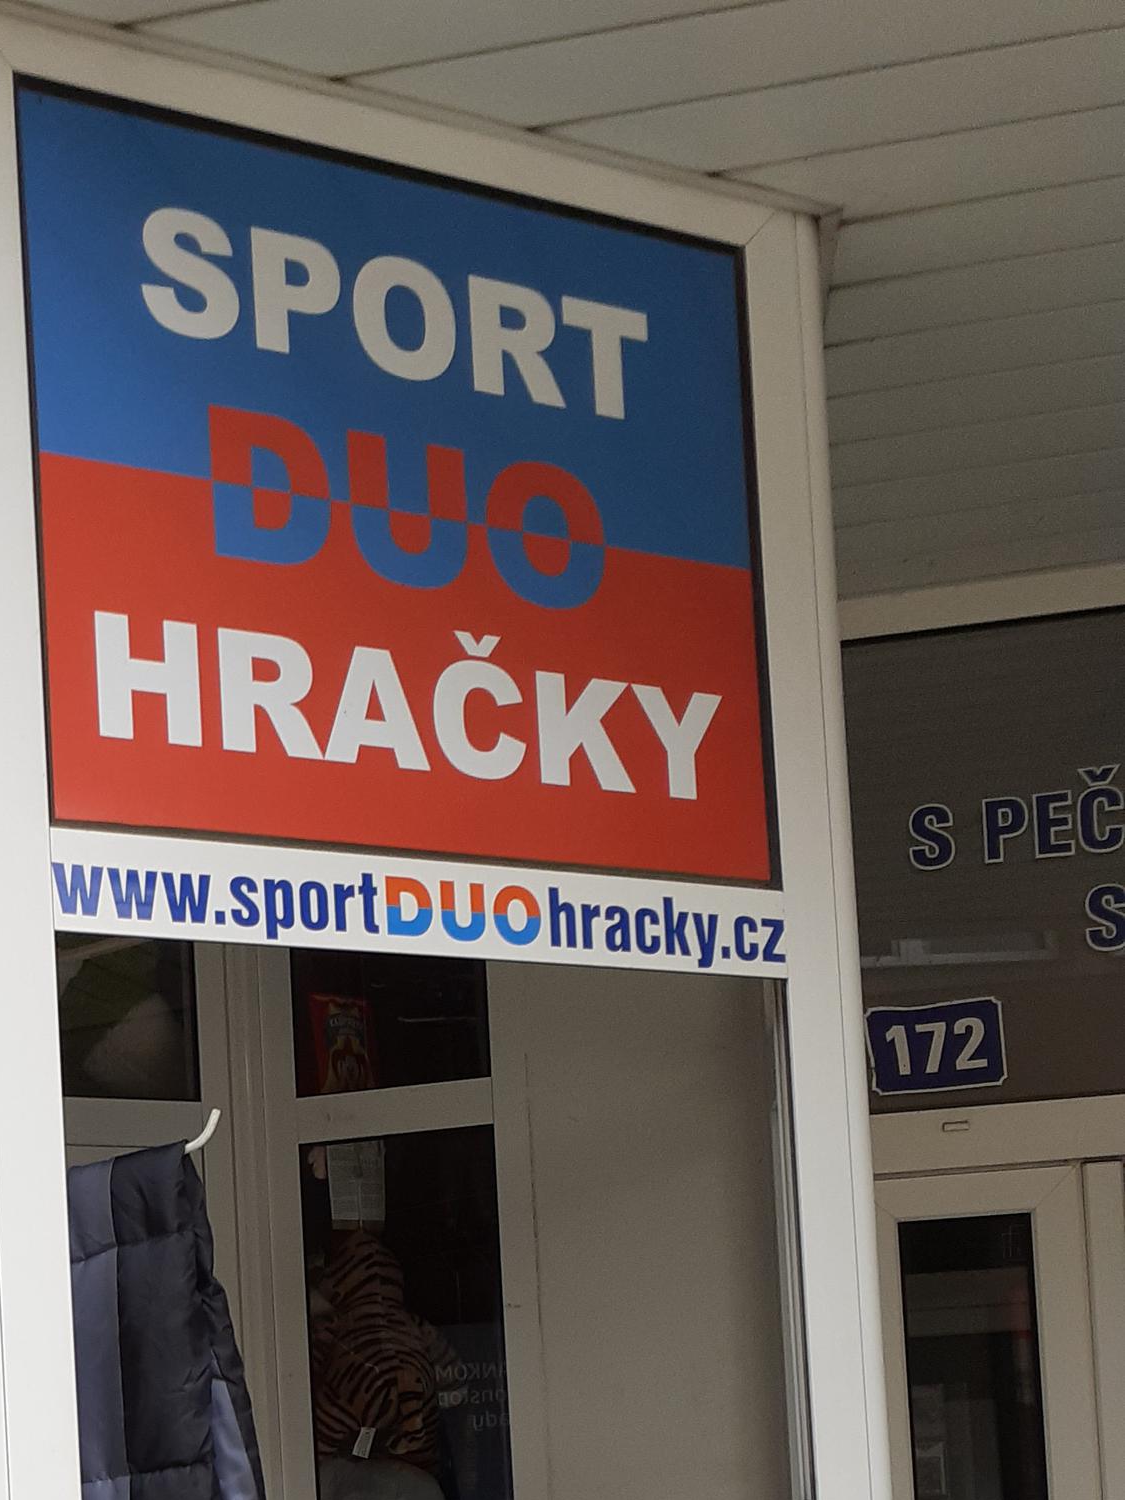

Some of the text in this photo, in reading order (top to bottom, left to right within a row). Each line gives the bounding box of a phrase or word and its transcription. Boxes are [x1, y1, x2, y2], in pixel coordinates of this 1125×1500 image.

[141, 208, 648, 419] SPORT
[209, 404, 607, 609] DUO
[95, 610, 722, 799] HRAČKY
[910, 804, 955, 871] S
[52, 862, 785, 968] www.sportDUOhracky.cz
[886, 1018, 988, 1076] 172
